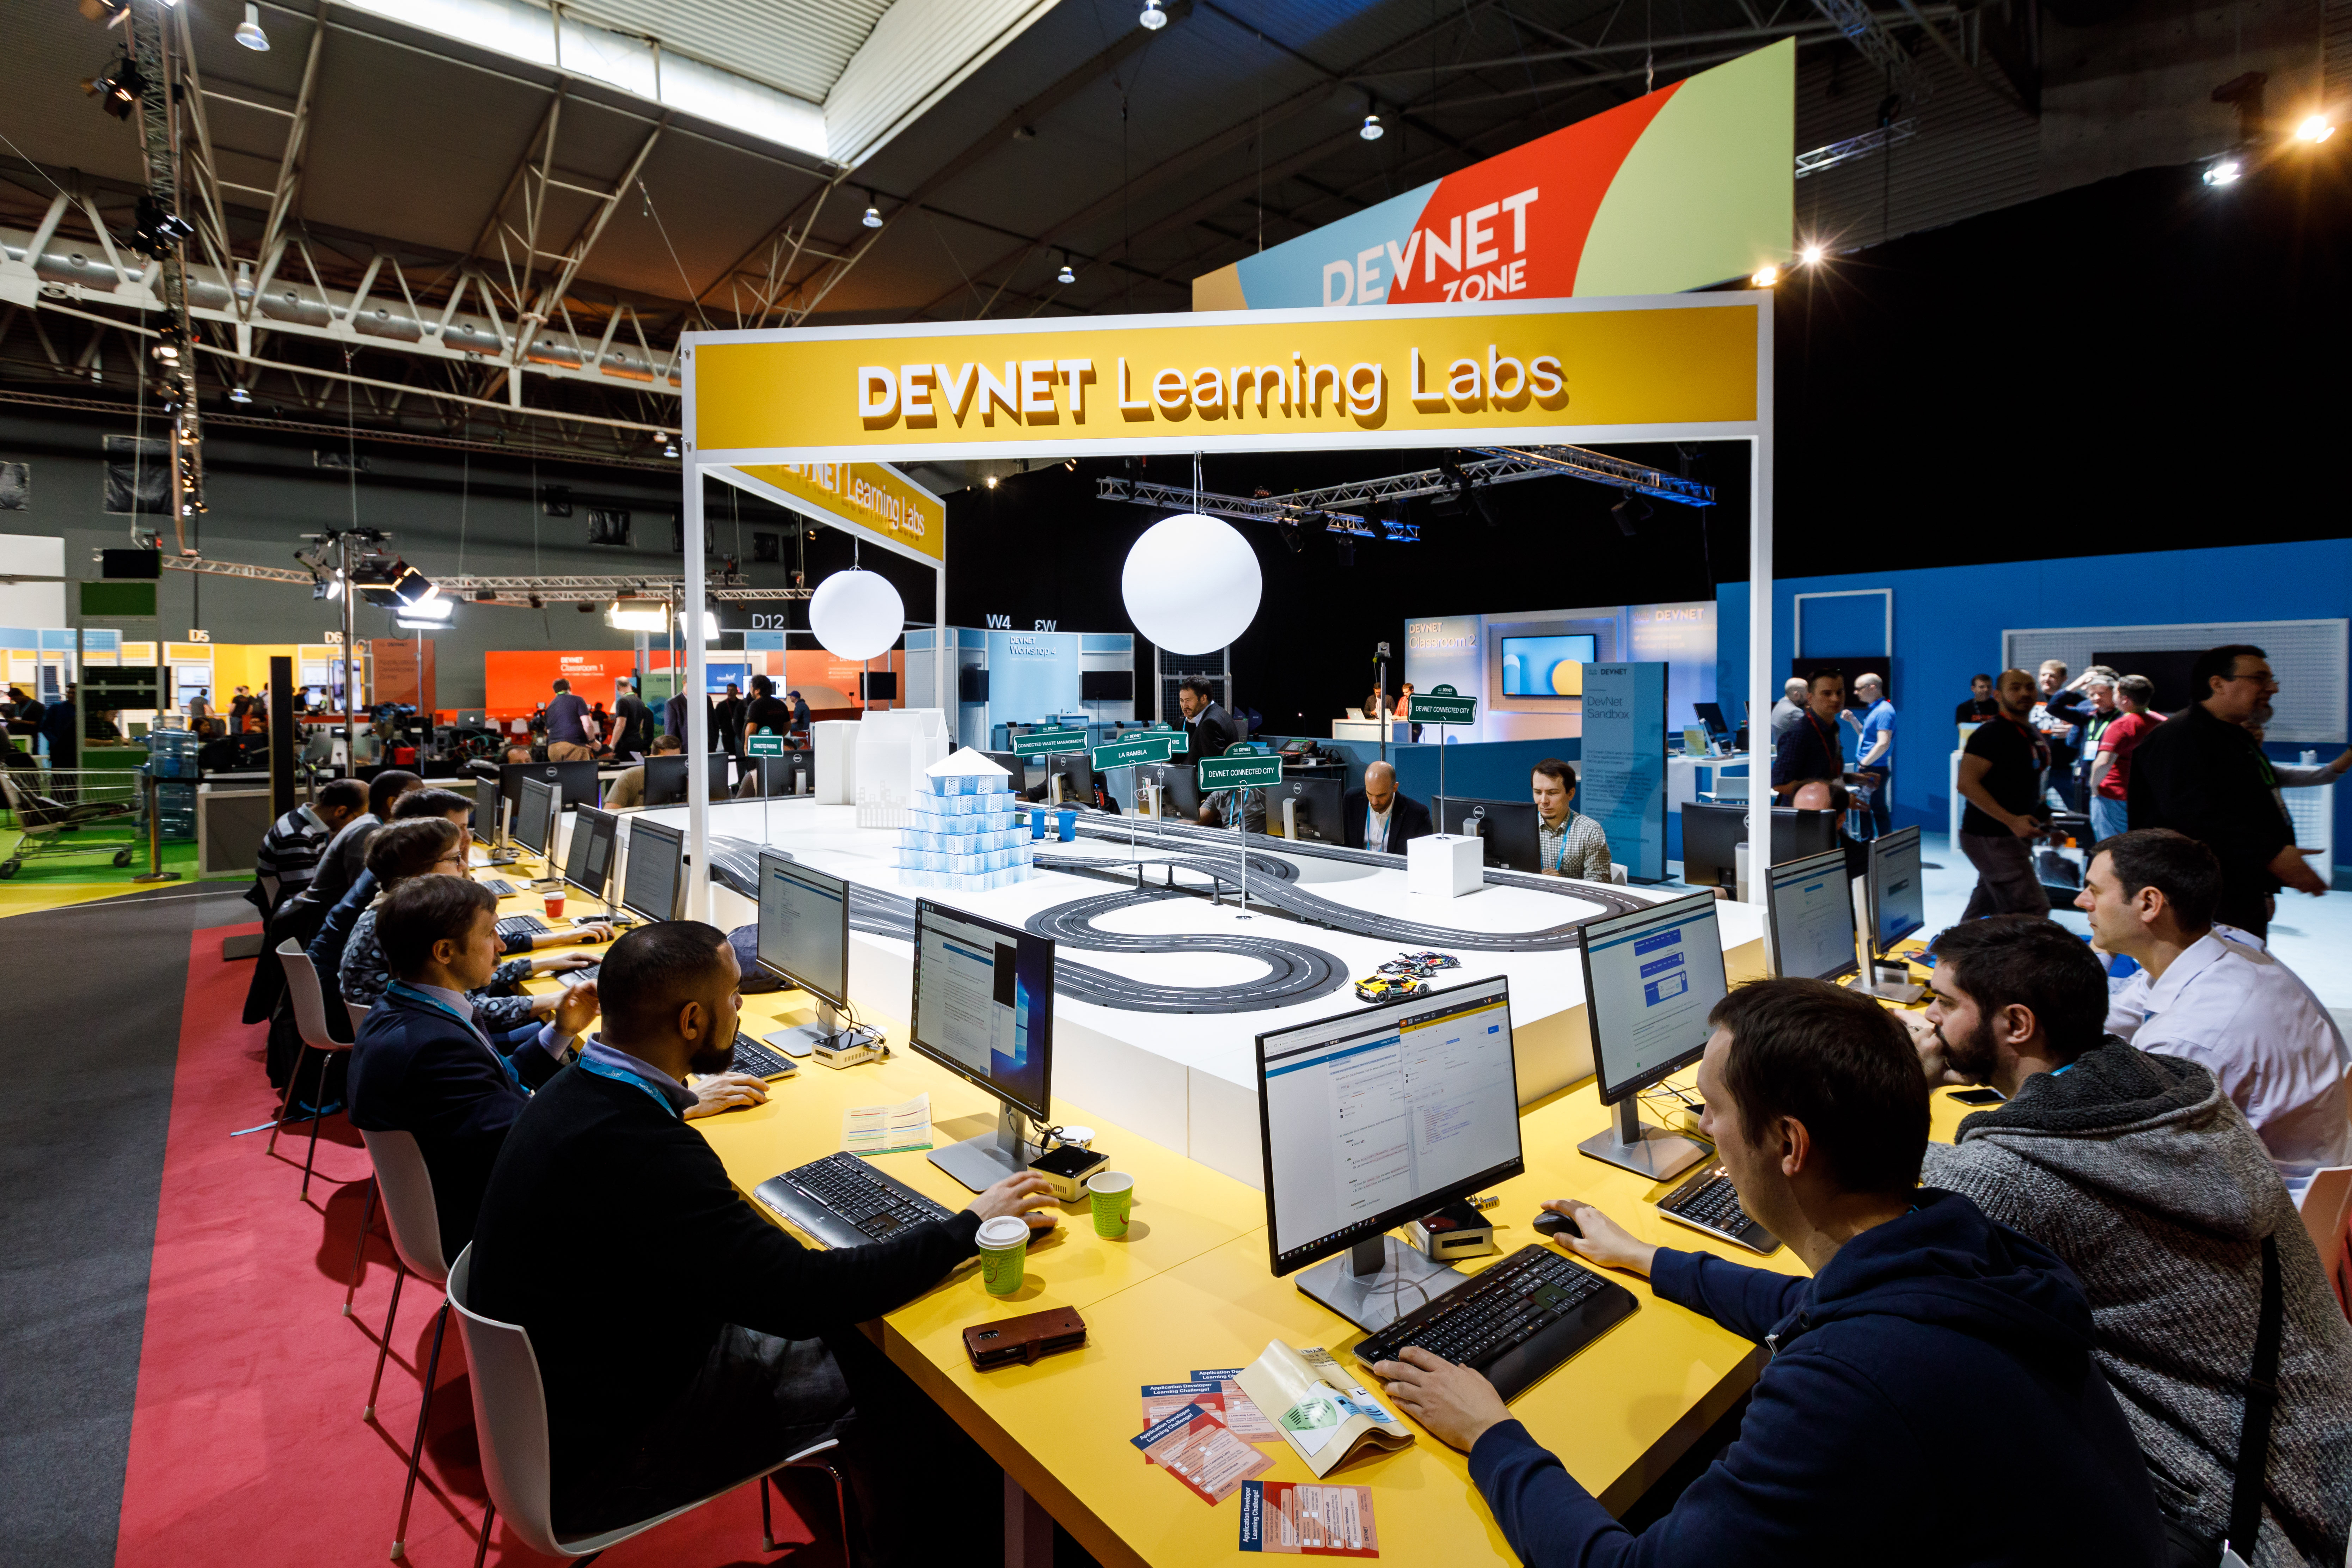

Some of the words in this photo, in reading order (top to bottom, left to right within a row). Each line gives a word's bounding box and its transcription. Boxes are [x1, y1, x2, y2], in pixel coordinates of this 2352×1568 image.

[1323, 186, 1538, 307] DEVNET
[1443, 258, 1526, 302] ZONE
[859, 359, 1094, 421] DEVNET
[1117, 351, 1383, 415] Learning
[1411, 345, 1564, 402] Labs
[847, 463, 899, 529] Learning
[902, 496, 925, 536] Labs
[1656, 608, 1704, 621] DEVNET
[752, 614, 784, 629] D12
[986, 614, 1011, 629] W4
[1409, 622, 1443, 633] DEVNET
[189, 629, 209, 642] D5
[324, 631, 343, 644] D6
[1010, 636, 1036, 644] DEVNET
[1409, 637, 1467, 649] Classroom
[1469, 634, 1476, 648] 2
[1010, 645, 1049, 656] Workshop
[1051, 647, 1056, 655] 4
[1588, 696, 1622, 706] DevNet
[1588, 709, 1629, 719] Sandbox
[1350, 1198, 1365, 1206] Authentication
[1139, 1420, 1170, 1440] Application
[1167, 1408, 1190, 1425] Developer
[1146, 1427, 1171, 1443] Learning
[1169, 1413, 1194, 1430] Challenge!
[1219, 1482, 1233, 1493] DEVNET
